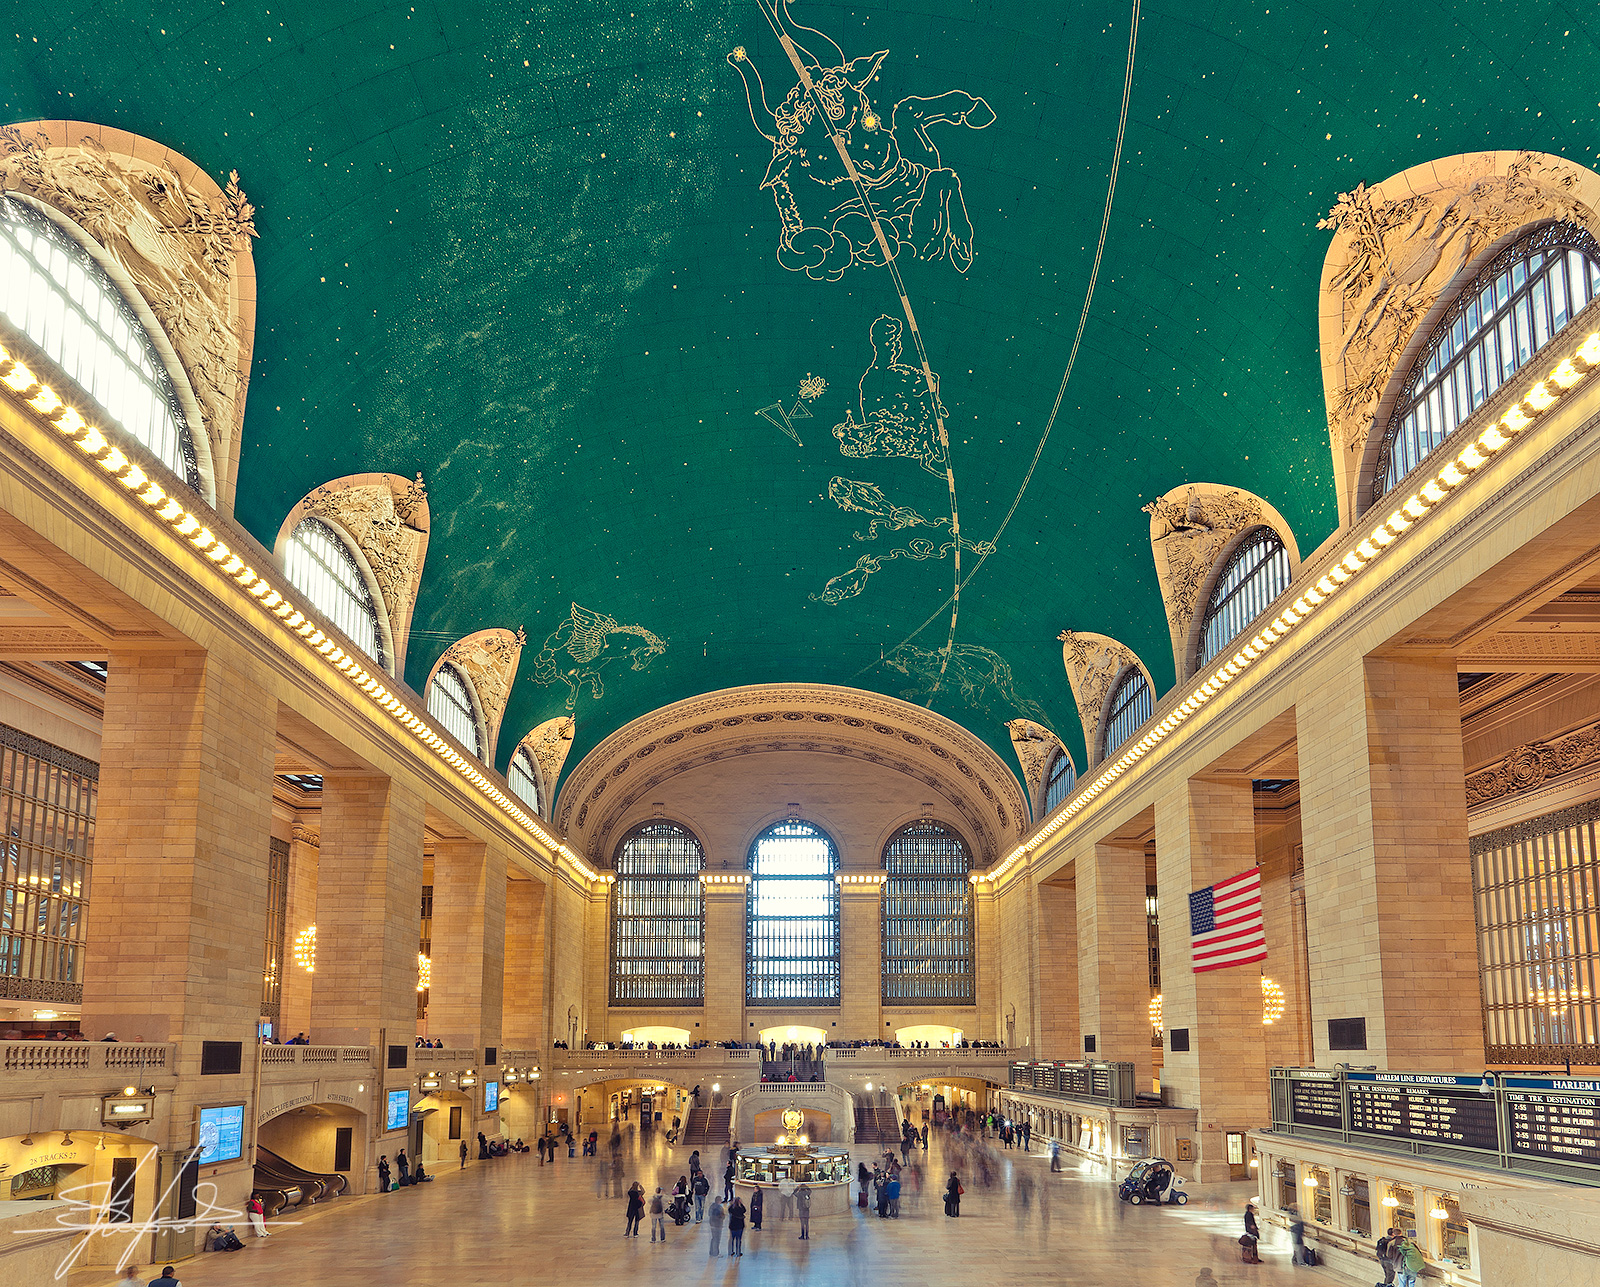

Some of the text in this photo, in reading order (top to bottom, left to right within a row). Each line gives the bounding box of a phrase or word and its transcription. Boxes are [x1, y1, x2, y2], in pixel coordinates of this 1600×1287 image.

[1415, 1076, 1456, 1084] DEPARTURES
[1552, 1080, 1594, 1090] HARLEM
[338, 1094, 354, 1104] STREET
[1546, 1096, 1596, 1106] DESTINATION
[266, 1102, 288, 1116] METLIFE
[290, 1095, 313, 1106] BUILDING
[1572, 1108, 1593, 1116] PLAINS
[1573, 1118, 1594, 1126] PLAINS
[1552, 1135, 1562, 1143] NO.
[1574, 1137, 1596, 1147] PLAINS
[39, 1152, 68, 1162] TRACKS
